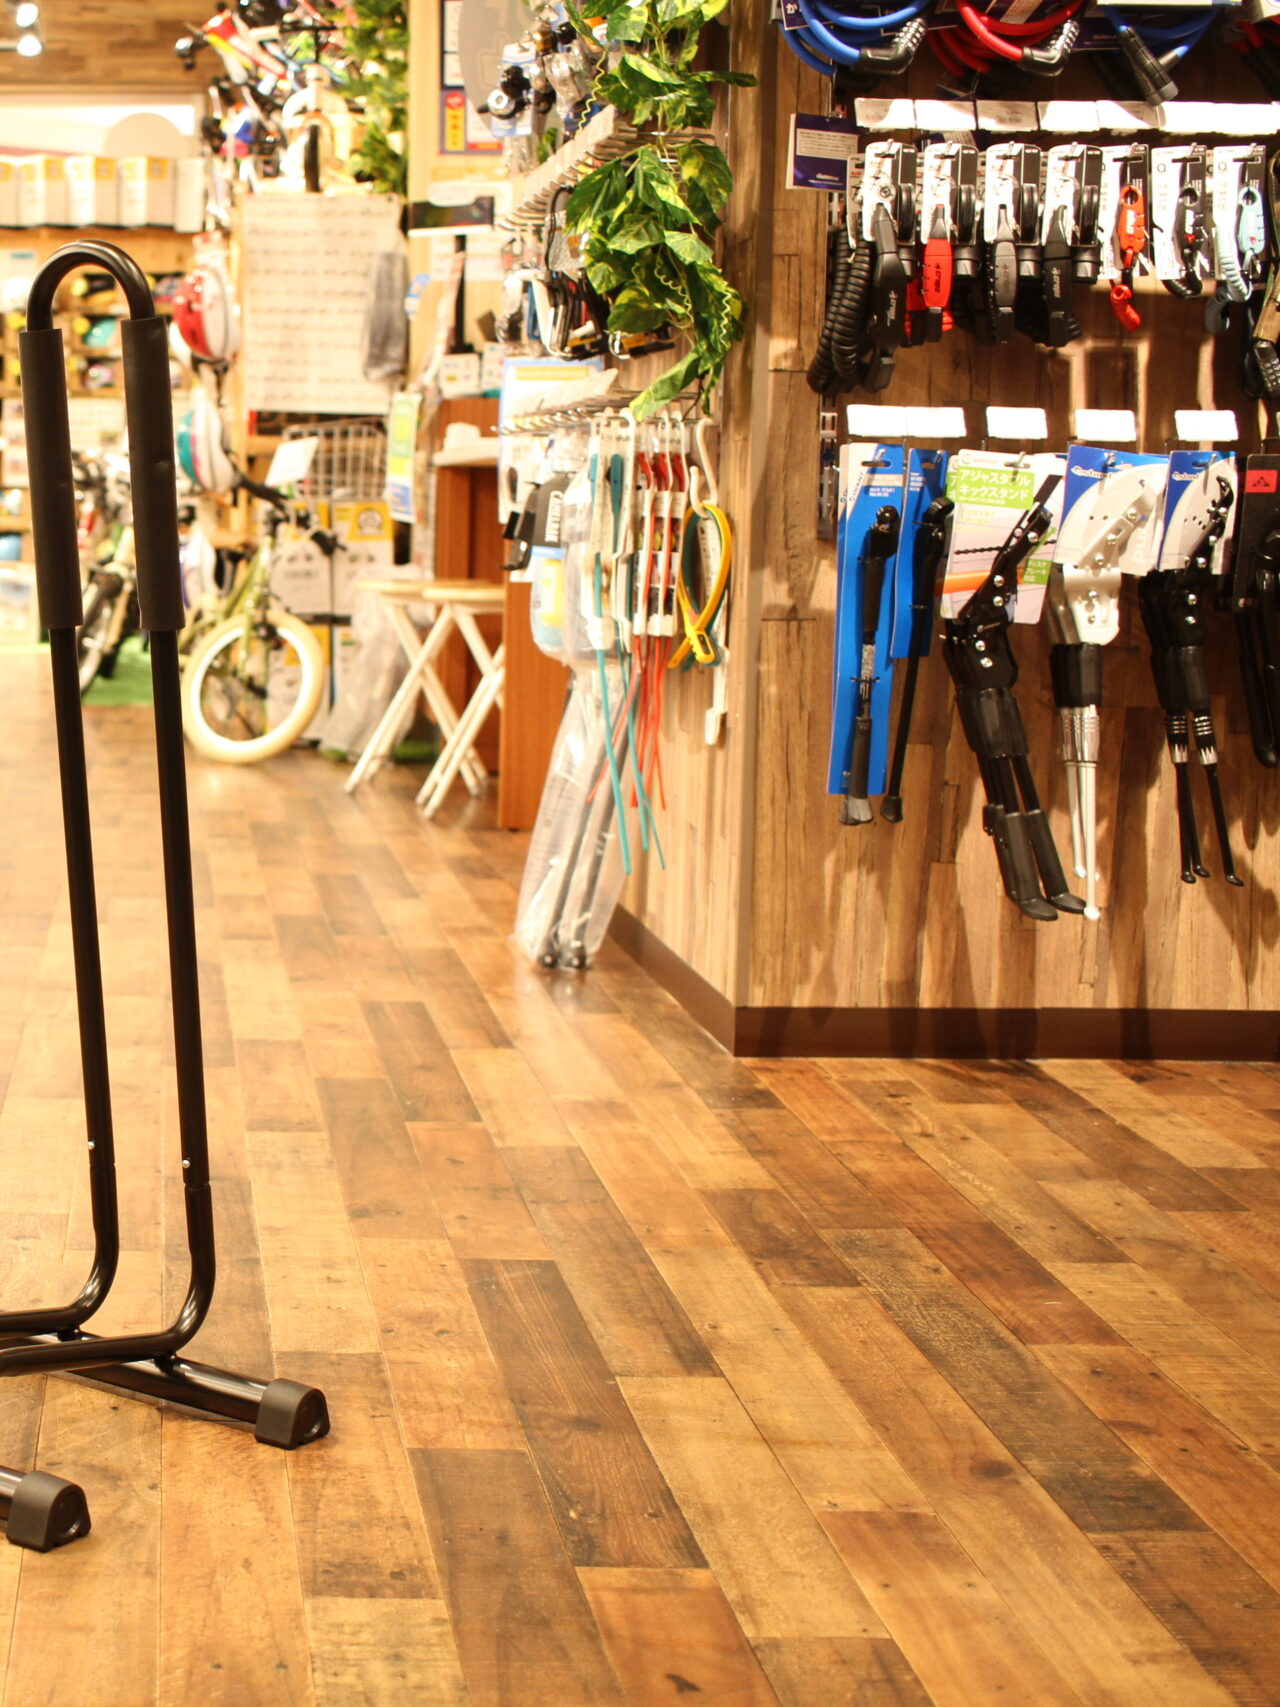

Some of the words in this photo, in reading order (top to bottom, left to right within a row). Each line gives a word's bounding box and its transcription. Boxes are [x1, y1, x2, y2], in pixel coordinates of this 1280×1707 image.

[958, 484, 1030, 501] キックスタンド
